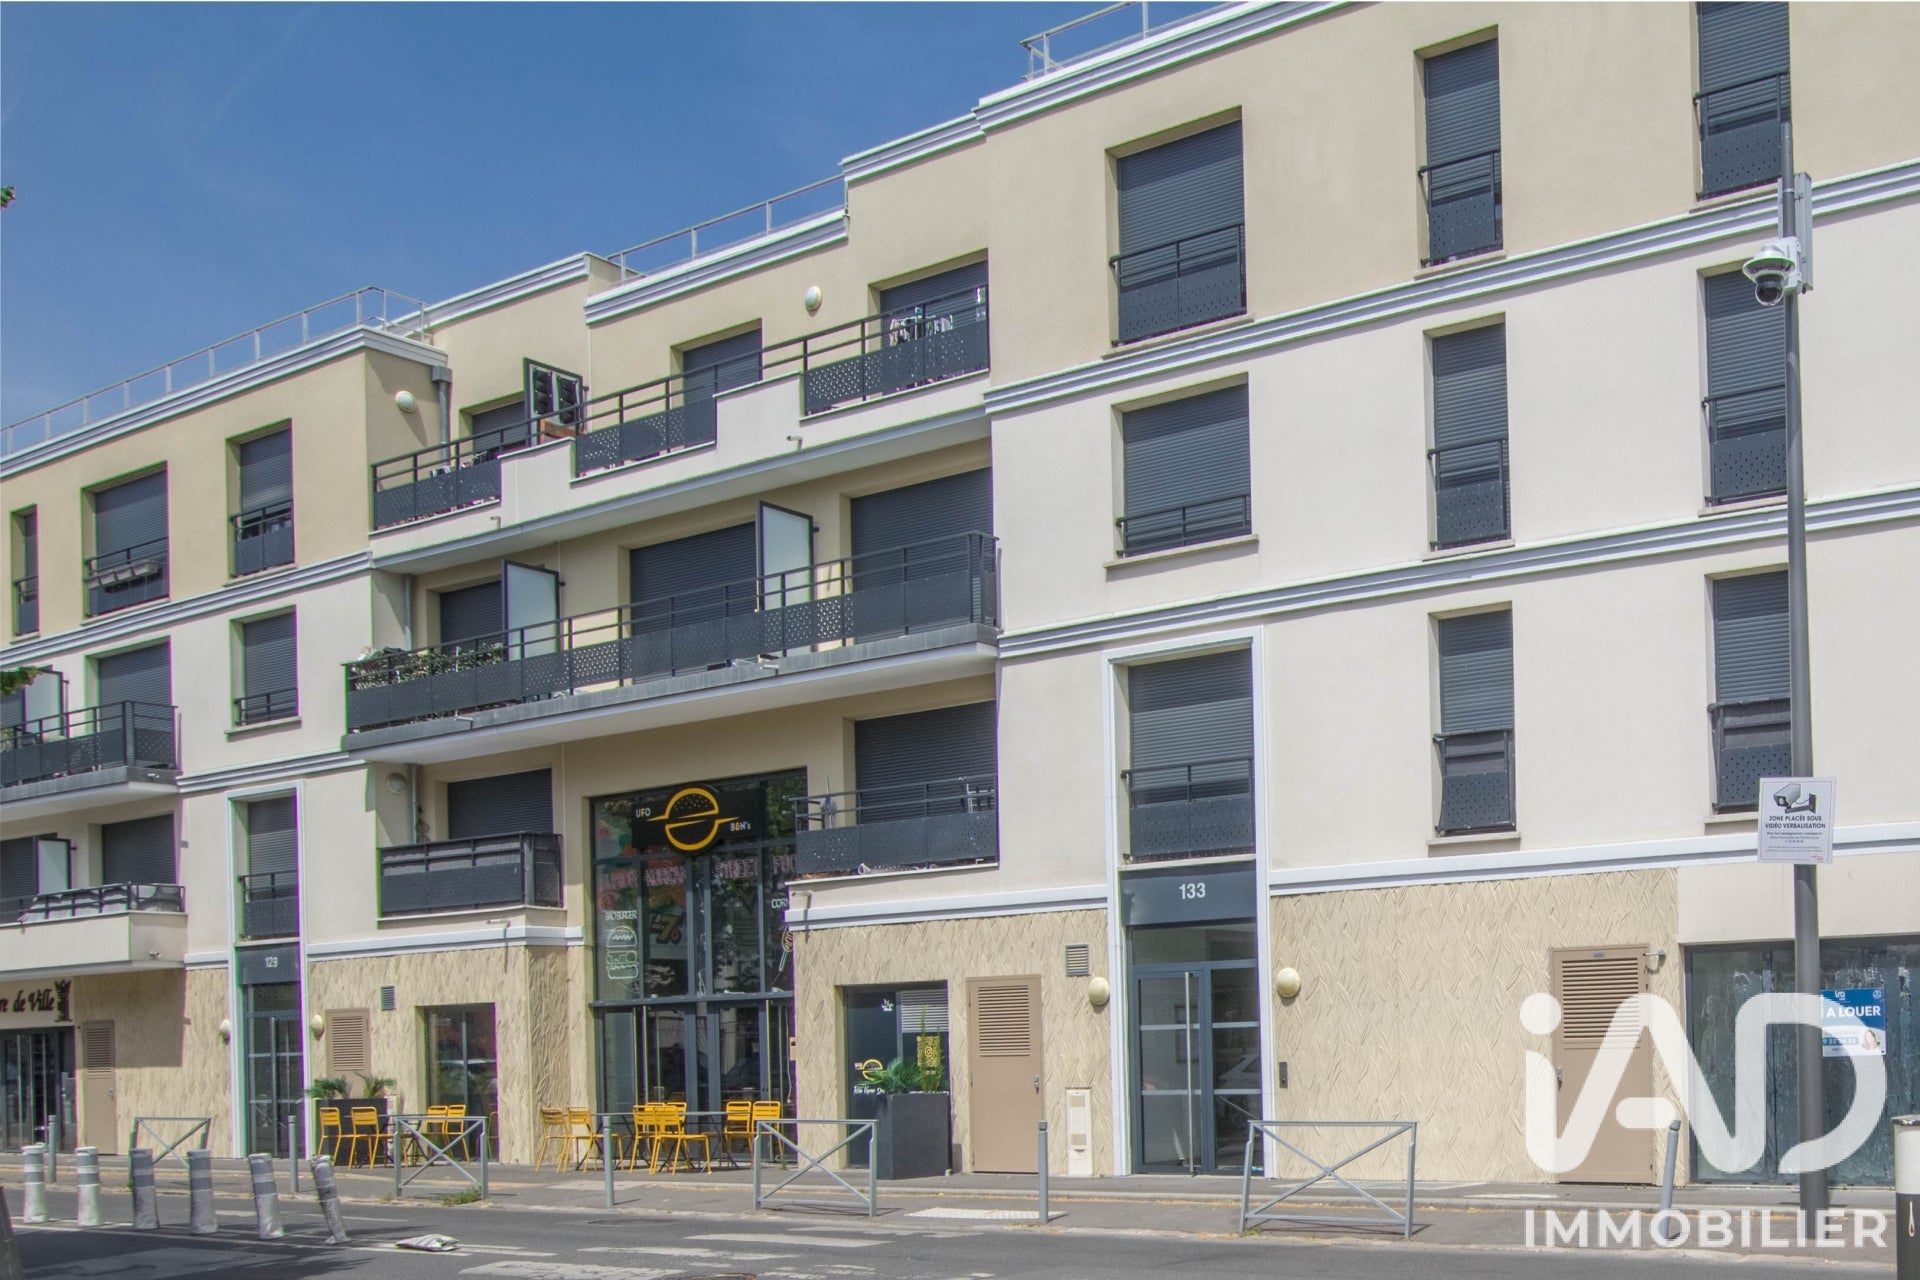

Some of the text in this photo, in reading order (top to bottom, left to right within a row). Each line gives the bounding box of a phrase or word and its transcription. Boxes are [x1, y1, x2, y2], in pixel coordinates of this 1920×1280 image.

[635, 808, 651, 818] UFO
[715, 858, 759, 879] STREET
[1179, 882, 1206, 900] 133
[264, 956, 278, 968] 129
[12, 990, 27, 1013] de
[28, 988, 55, 1012] Ville
[1826, 1005, 1882, 1018] A LOUER
